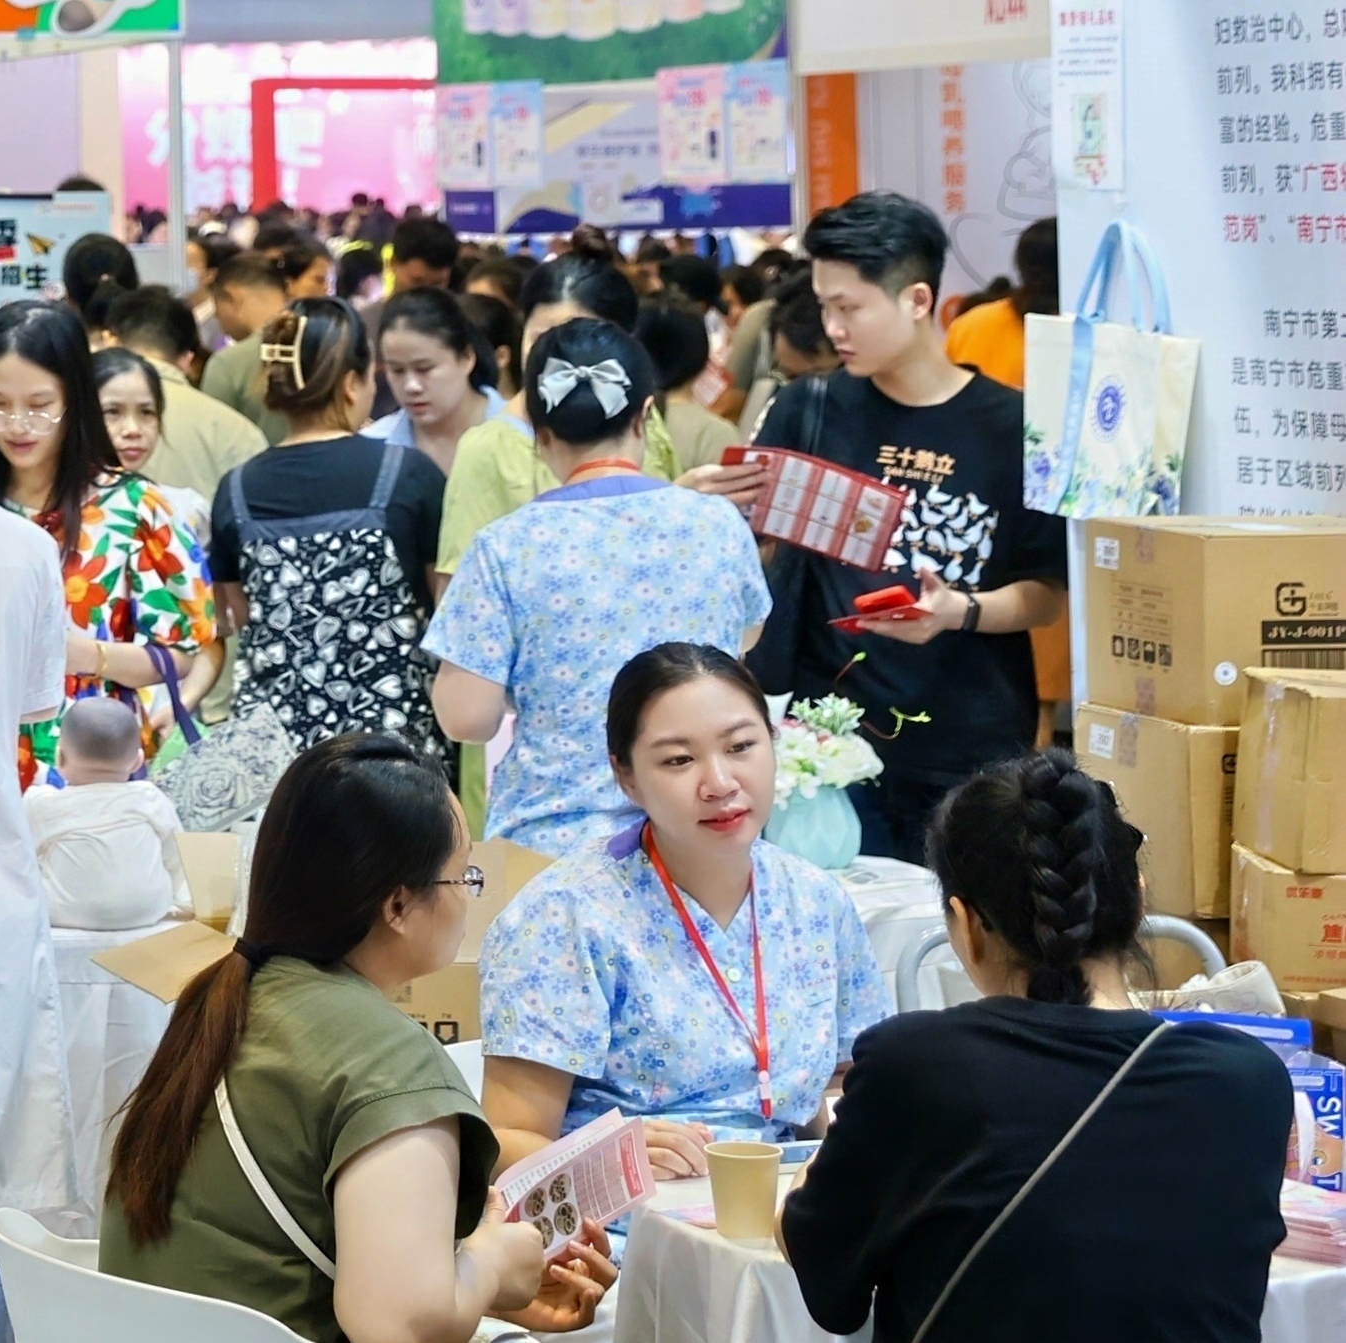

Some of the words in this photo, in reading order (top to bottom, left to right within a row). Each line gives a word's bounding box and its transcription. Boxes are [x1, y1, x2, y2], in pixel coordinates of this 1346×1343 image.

[1214, 8, 1346, 45] 妇救治中心，总
[1231, 357, 1346, 391] 是南宁市危重
